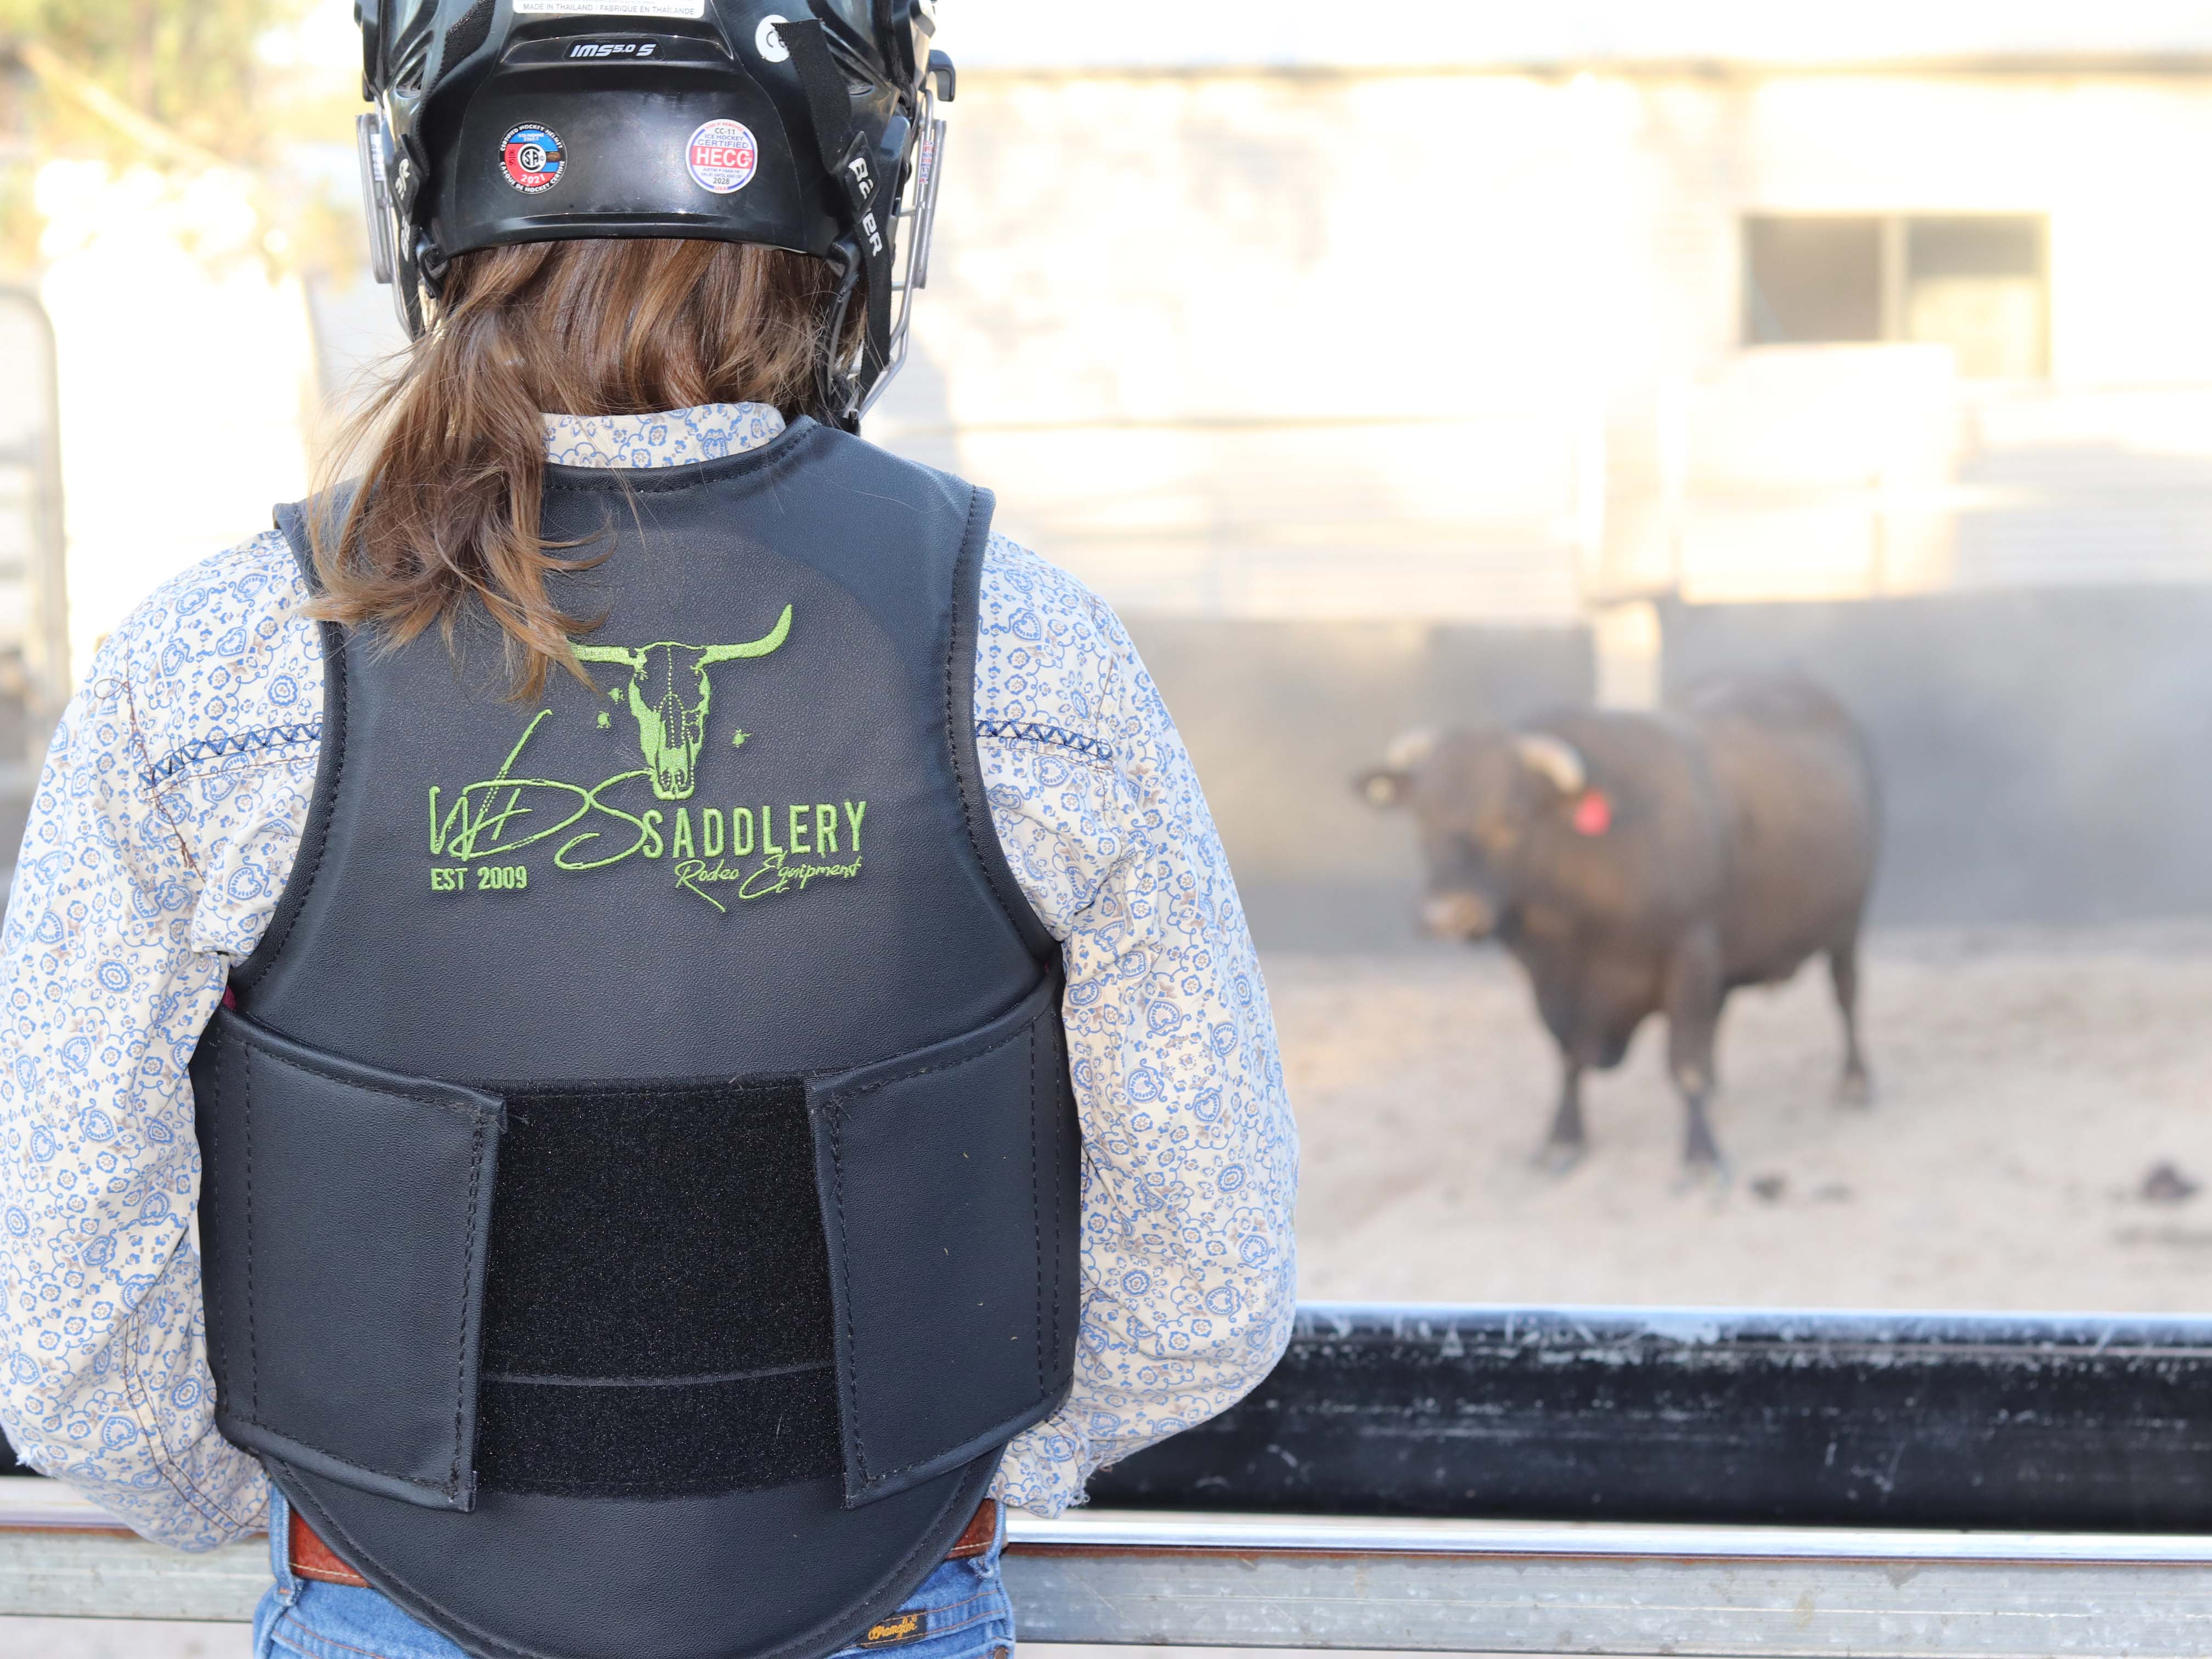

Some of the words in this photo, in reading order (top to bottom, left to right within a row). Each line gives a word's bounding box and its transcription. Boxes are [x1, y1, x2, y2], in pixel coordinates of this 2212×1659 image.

[600, 4, 637, 13] FABRIQUE
[636, 44, 657, 57] S
[722, 122, 744, 132] REMOVED
[500, 128, 519, 151] CERTIFIED
[545, 128, 563, 149] HELMET
[697, 139, 749, 149] CERTIFIED
[500, 161, 516, 185] CASQUE
[524, 182, 550, 193] HOCKEY
[520, 173, 546, 184] 2021
[642, 800, 867, 859] SADDLERY
[431, 867, 468, 891] EST
[477, 865, 528, 891] 2009
[674, 858, 740, 912] Rodeo
[738, 850, 864, 900] Equipment
